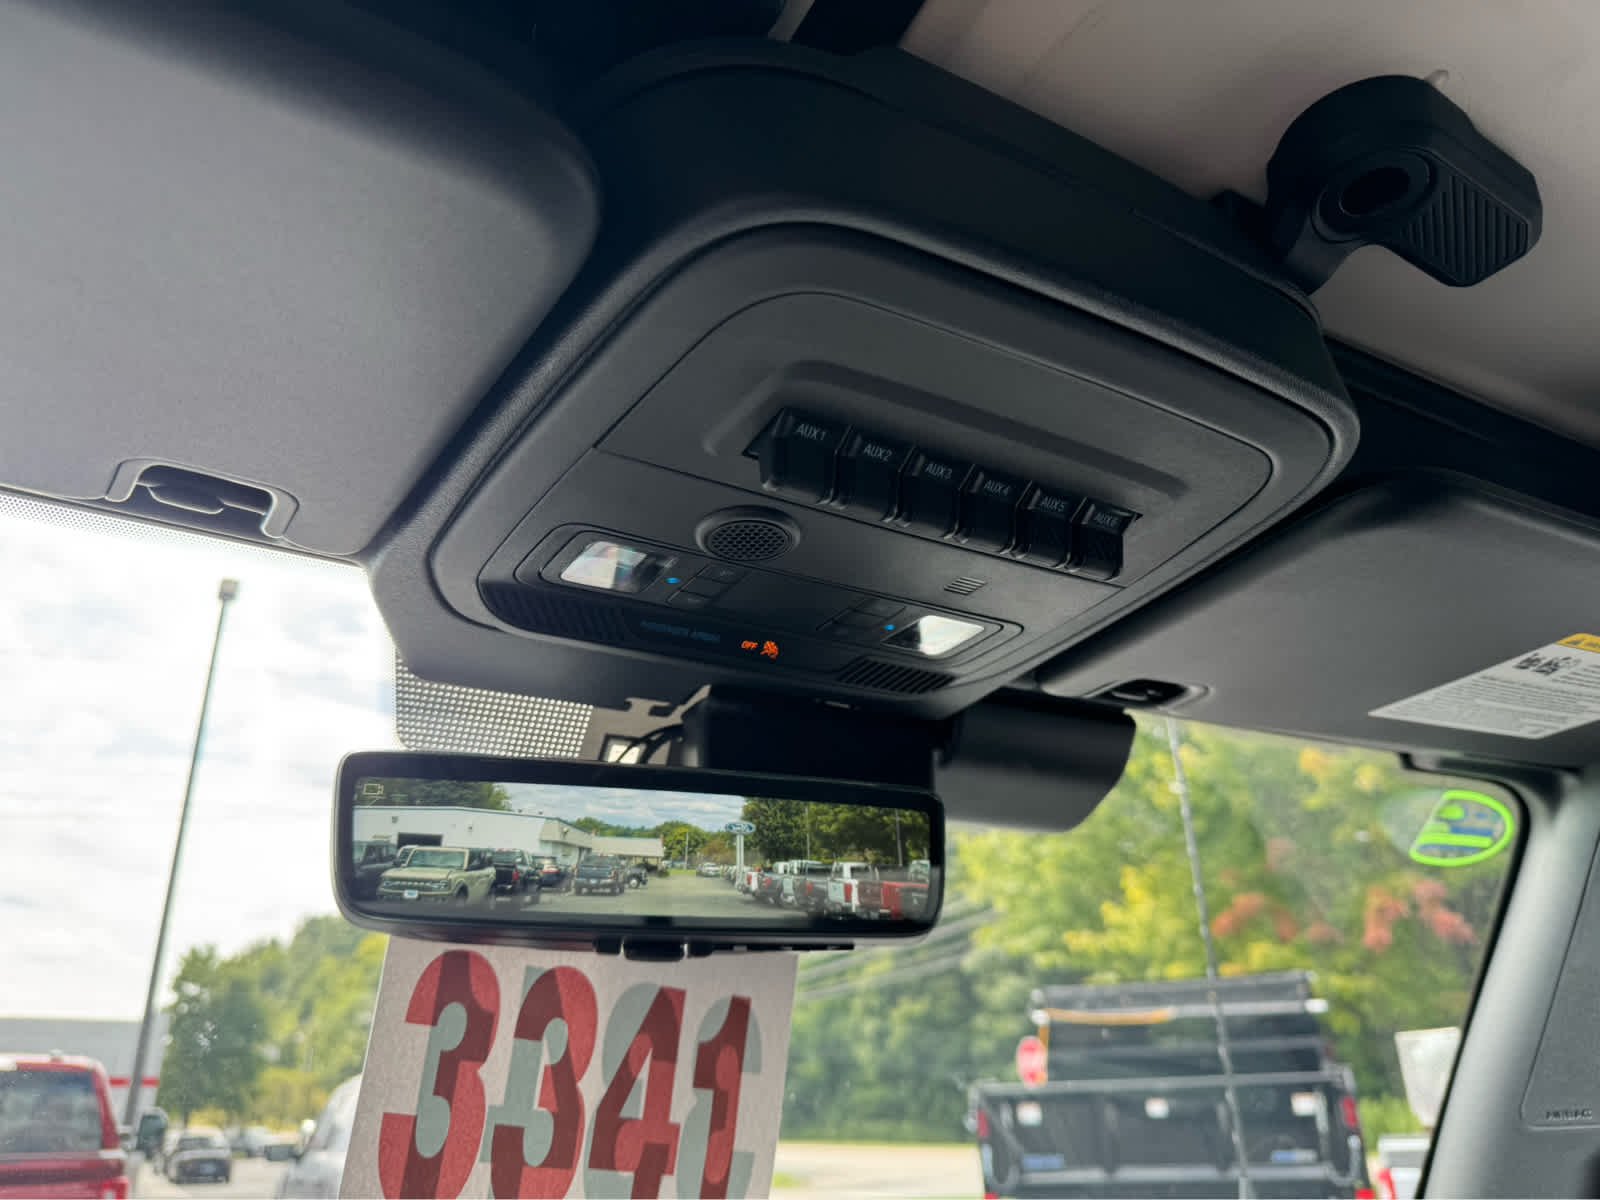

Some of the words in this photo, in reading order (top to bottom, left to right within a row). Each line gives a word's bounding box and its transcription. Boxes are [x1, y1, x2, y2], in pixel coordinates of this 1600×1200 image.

[796, 423, 827, 440] AUX1
[863, 442, 893, 462] AUX2
[925, 462, 953, 480] AUX3
[984, 479, 1009, 496] AUX4
[741, 640, 759, 650] OFF
[378, 949, 752, 1200] 3341
